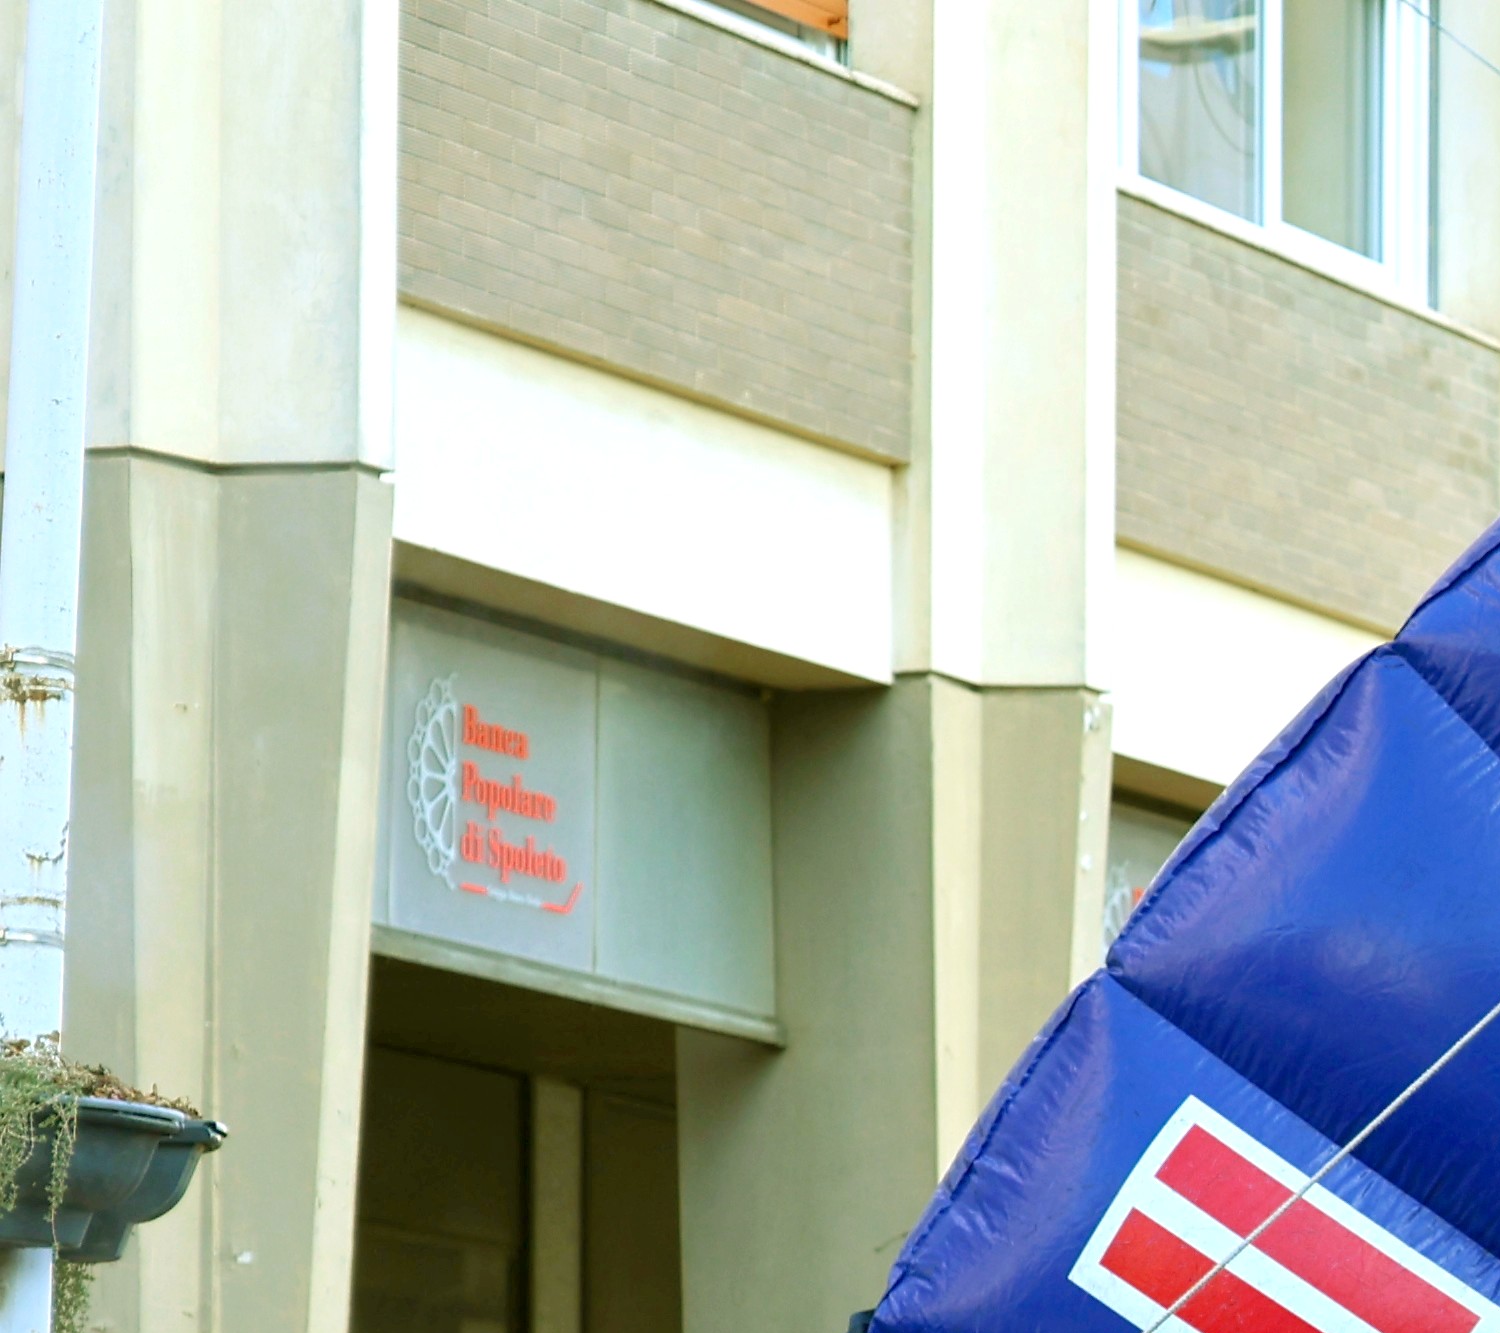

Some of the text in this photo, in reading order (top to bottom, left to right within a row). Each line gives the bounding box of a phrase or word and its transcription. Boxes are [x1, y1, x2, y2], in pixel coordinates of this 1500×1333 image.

[463, 703, 529, 760] Banca
[463, 760, 557, 822] Popolare
[461, 820, 567, 884] di Spoleto
